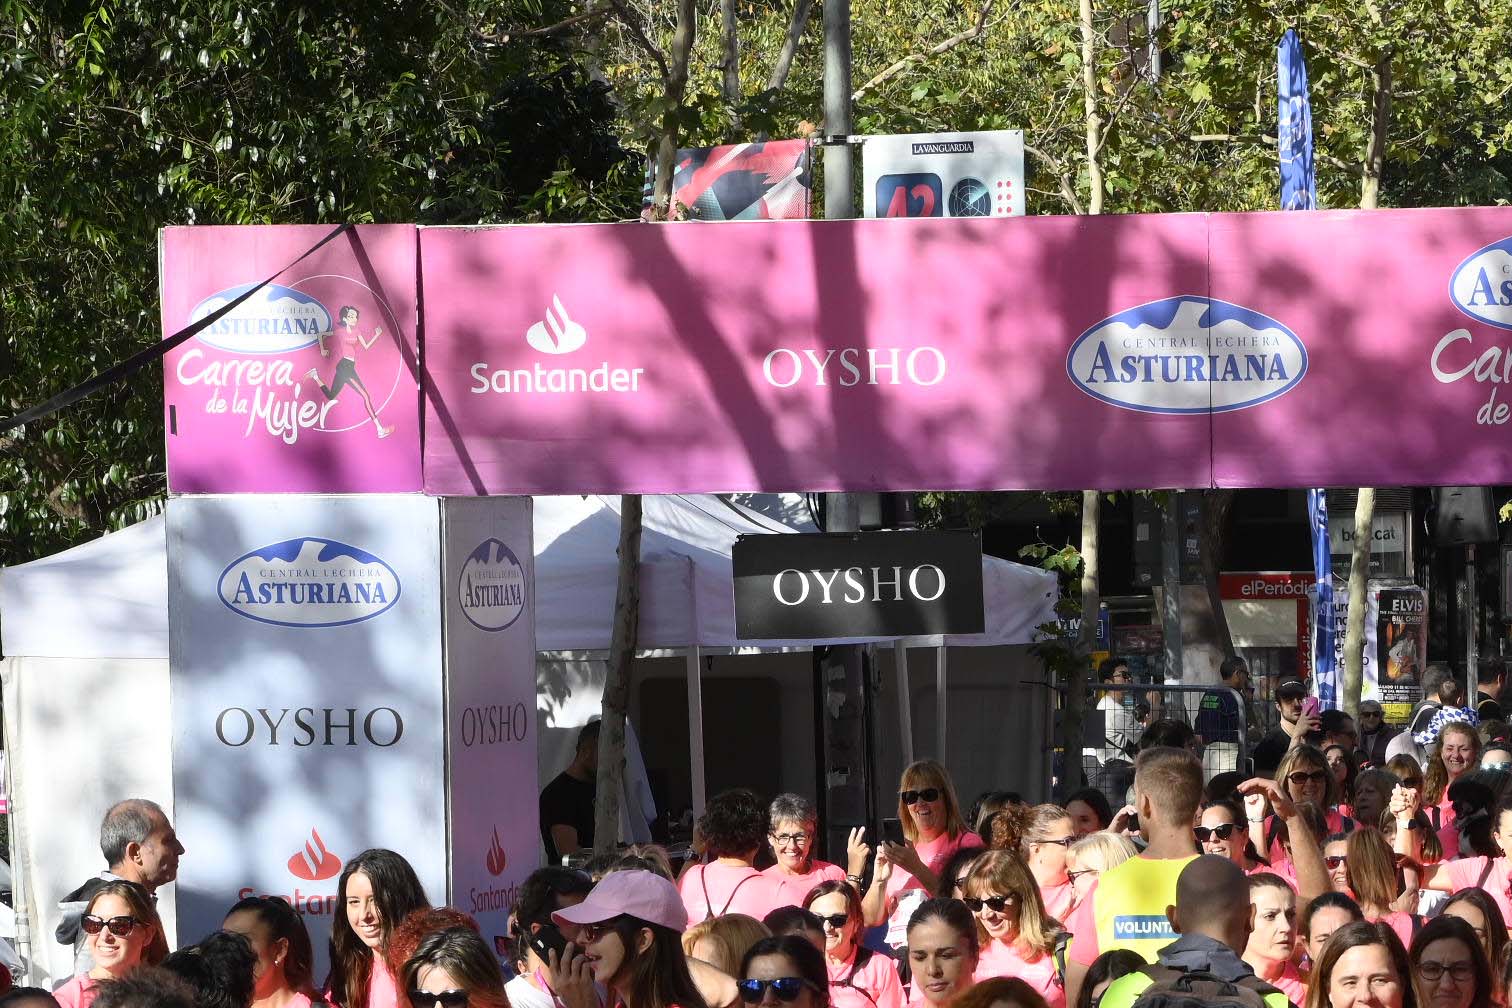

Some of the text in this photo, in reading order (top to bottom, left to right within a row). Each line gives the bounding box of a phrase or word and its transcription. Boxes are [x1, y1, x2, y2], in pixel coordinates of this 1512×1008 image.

[1123, 336, 1281, 348] CENTRAL LECHERA
[176, 349, 294, 386] Carrera
[470, 362, 643, 395] Santander
[763, 346, 946, 387] OYSHO
[1087, 342, 1290, 385] ASTURIANA
[206, 382, 339, 444] de la Mujer
[1476, 389, 1510, 426] de
[232, 571, 388, 605] ASTURIANA
[260, 568, 381, 578] CENTRAL LECHERA
[464, 572, 522, 608] ASTURIANA
[772, 564, 946, 606] OYSHO
[1241, 579, 1313, 596] elPeriódi
[1392, 599, 1423, 612] ELVIS
[215, 706, 404, 748] OYSHO
[461, 702, 527, 748] OYSHO
[470, 881, 519, 913] Santande
